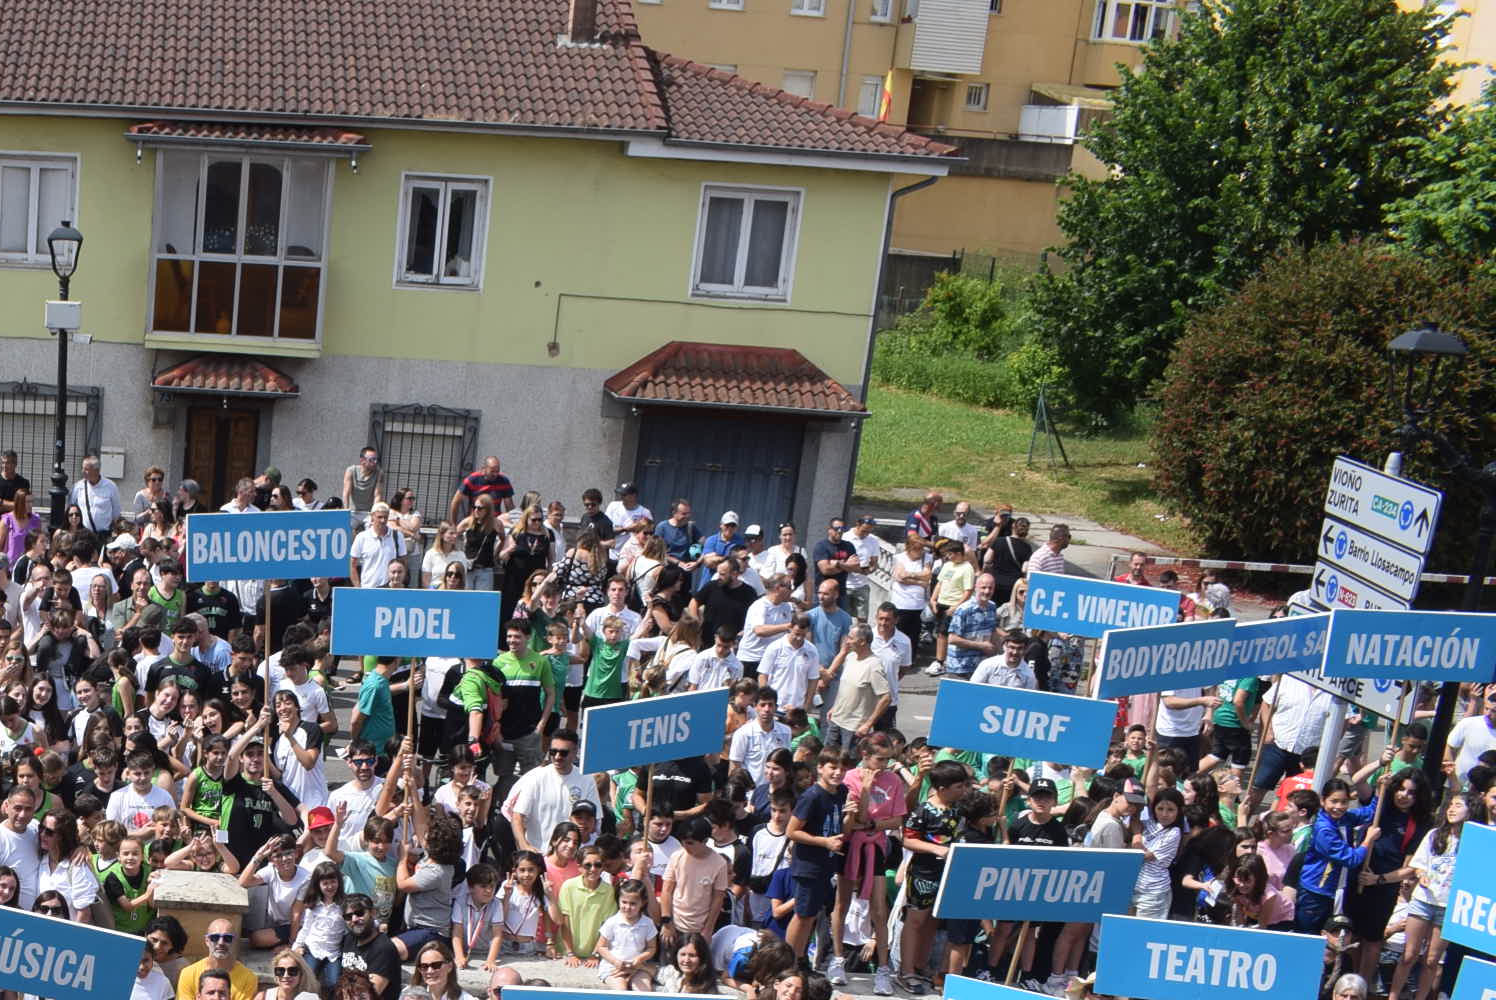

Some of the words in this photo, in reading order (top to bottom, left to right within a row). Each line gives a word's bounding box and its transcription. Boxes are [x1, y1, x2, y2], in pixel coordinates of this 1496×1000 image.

[1332, 468, 1362, 492] VIOÑO
[1328, 489, 1360, 516] ZURITA
[192, 527, 348, 565] BALONCESTO
[1348, 540, 1369, 562] Barrio
[374, 606, 456, 640] PADEL
[1031, 588, 1068, 618] C.F.
[1077, 594, 1176, 627] VIMENOR
[1106, 638, 1229, 681] BODYBOARD
[1227, 633, 1298, 667] FUTBOL
[1302, 629, 1325, 657] SA
[1345, 627, 1481, 670] NATACIÓN
[627, 711, 691, 750] TENIS
[979, 704, 1071, 743] SURF
[973, 866, 1105, 904] PINTURA
[1146, 942, 1277, 991] TEATRO
